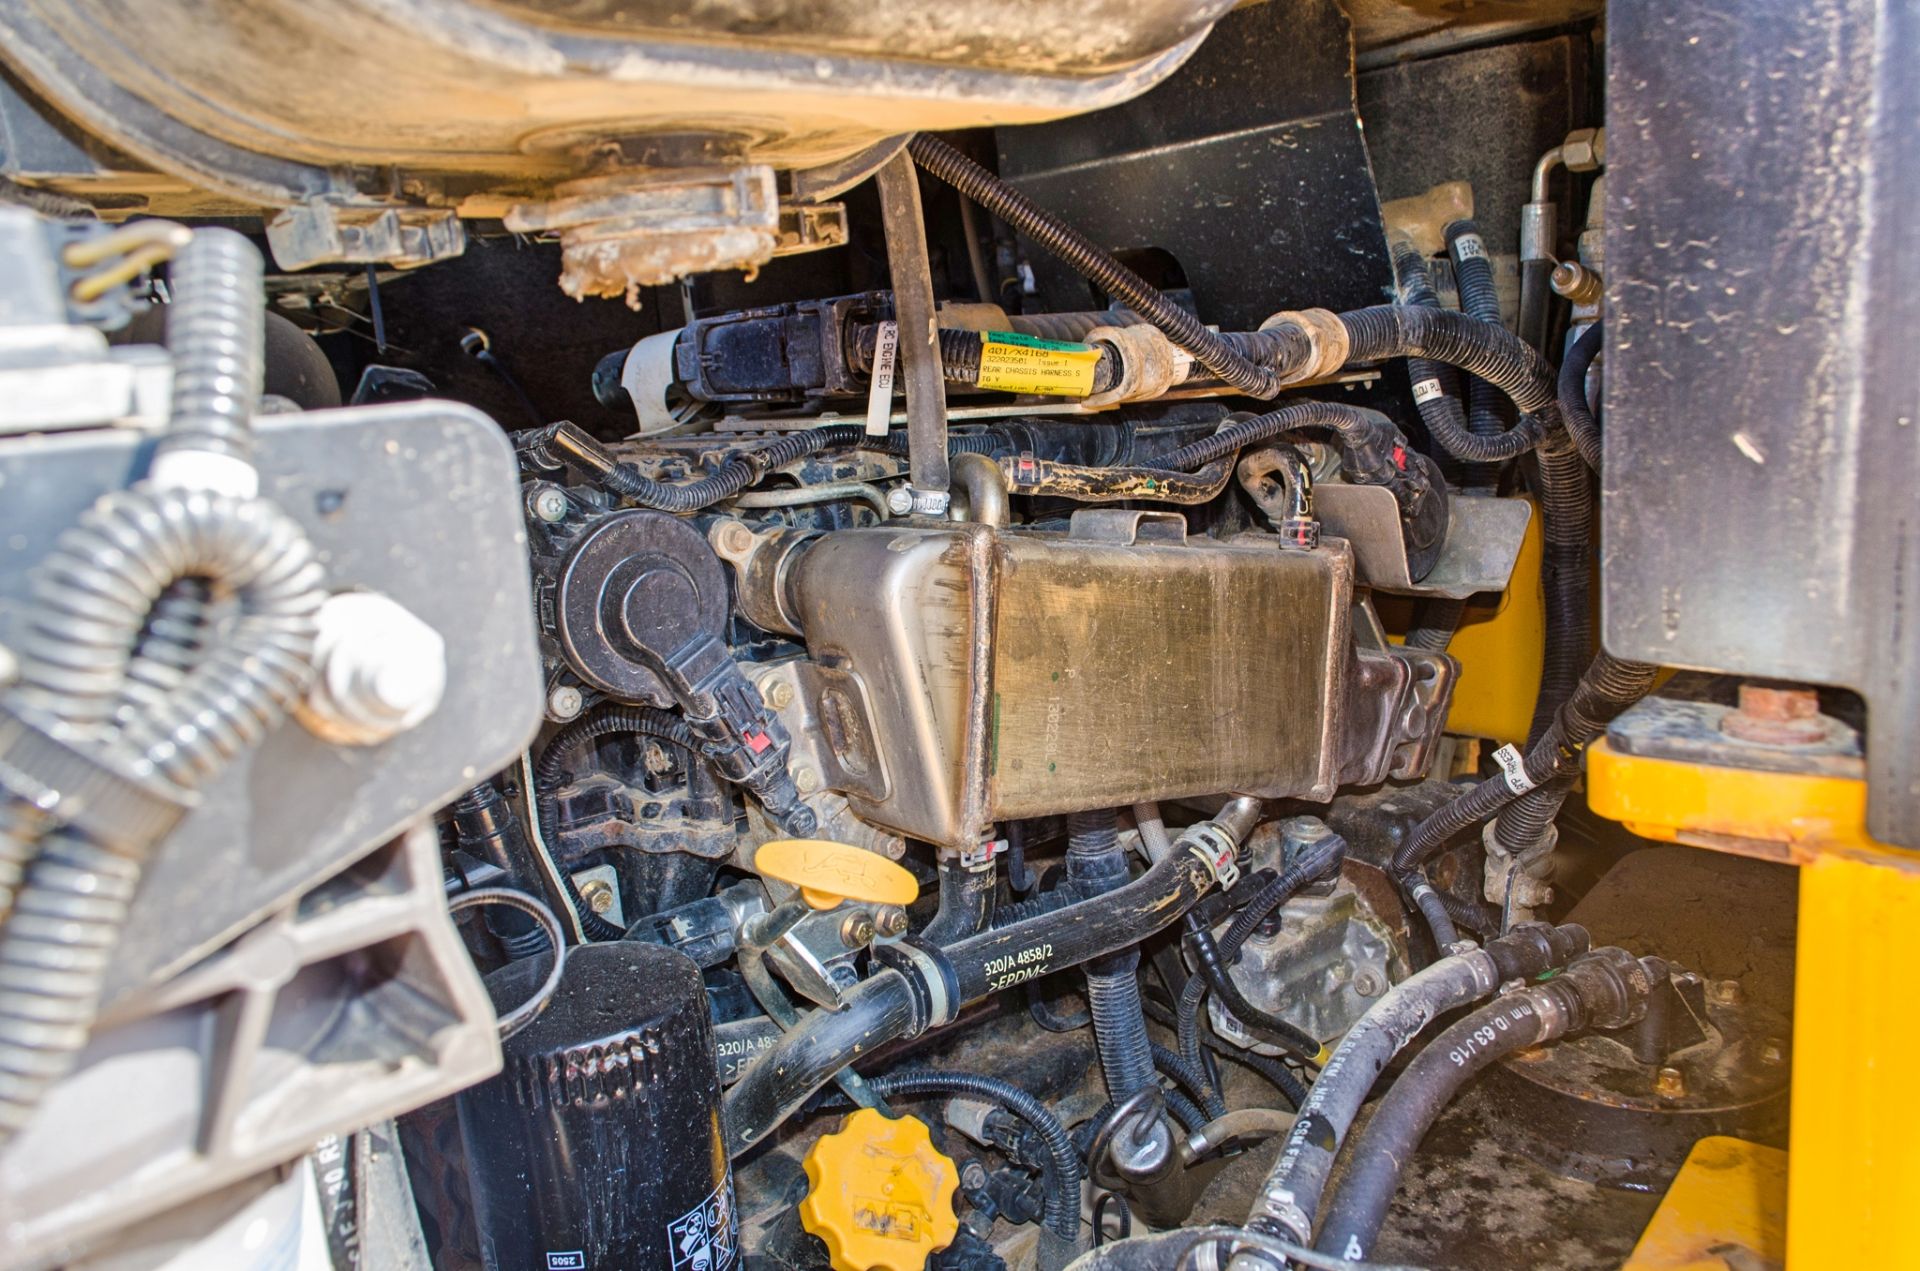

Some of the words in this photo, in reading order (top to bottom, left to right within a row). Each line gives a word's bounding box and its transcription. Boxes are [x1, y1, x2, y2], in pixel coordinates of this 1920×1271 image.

[880, 343, 894, 371] ENGINE
[1038, 359, 1058, 367] Issue
[982, 366, 1000, 374] REAR
[1005, 368, 1037, 376] CHASSIS
[1040, 369, 1072, 377] HARNESS
[1075, 369, 1080, 377] S
[878, 374, 890, 389] ECU
[984, 955, 1016, 976] 320/A
[1017, 944, 1053, 965] 4858/2
[1510, 1004, 1533, 1020] mm
[717, 1038, 755, 1057] 320/A
[757, 1036, 778, 1050] 48
[551, 1256, 576, 1266] 2505
